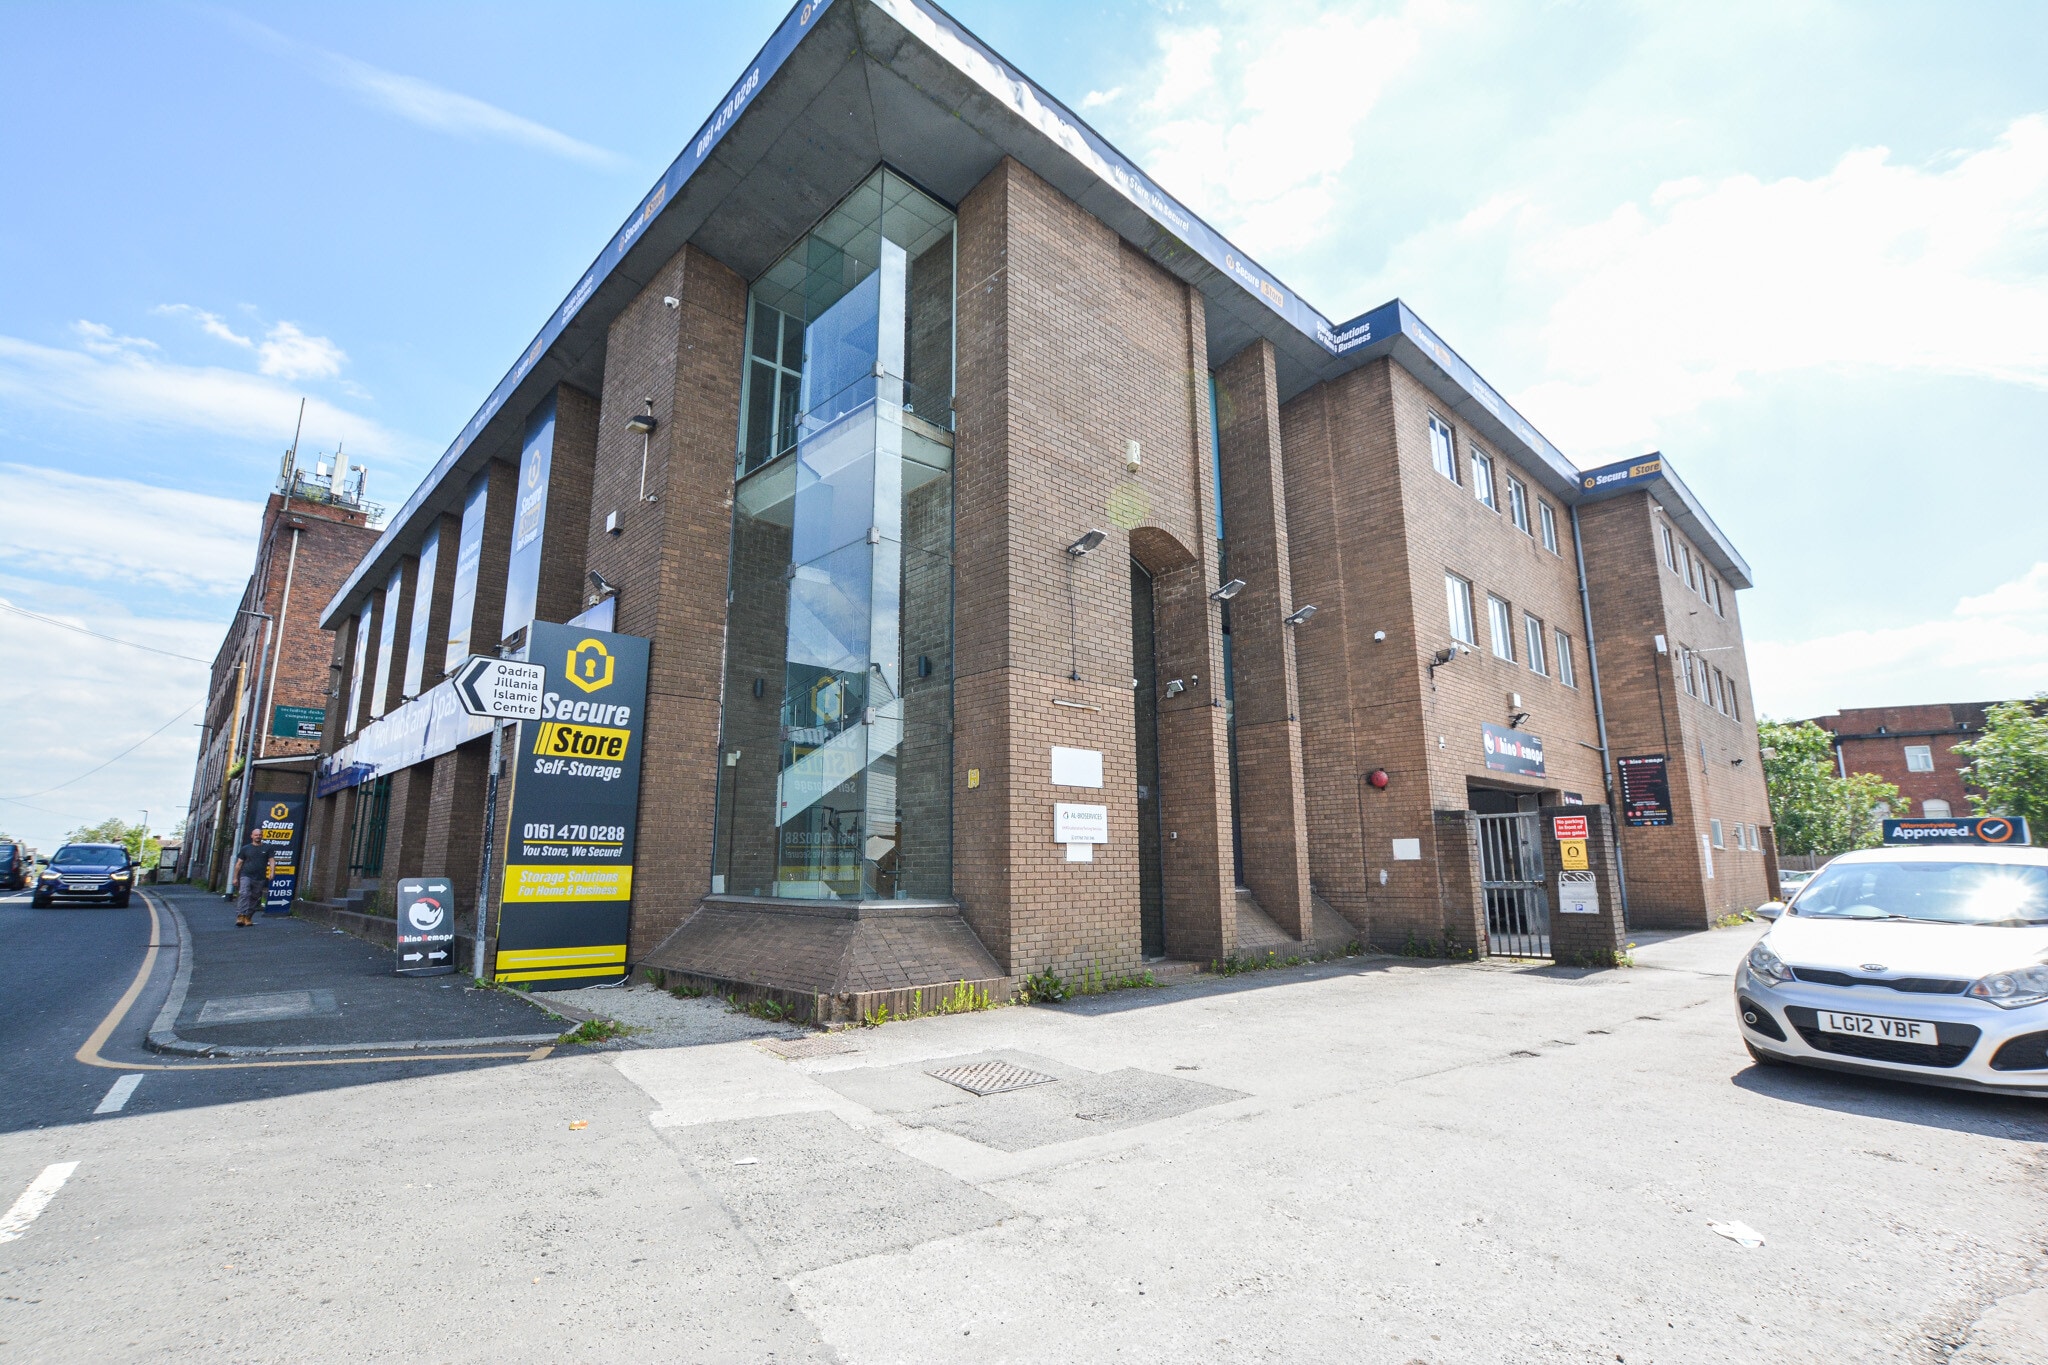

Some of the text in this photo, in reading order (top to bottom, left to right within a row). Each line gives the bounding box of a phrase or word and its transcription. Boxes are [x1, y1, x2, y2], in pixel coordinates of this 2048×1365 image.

[696, 67, 759, 158] 0161 470 0288
[1235, 261, 1282, 305] Secure Store
[1338, 332, 1371, 352] Business
[1596, 462, 1660, 484] Secure Store
[498, 664, 538, 678] Qadria
[494, 677, 538, 690] Jillania
[494, 688, 538, 702] Islamic
[431, 690, 457, 732] Spas
[493, 701, 536, 714] Centre
[542, 692, 630, 726] Secure
[554, 727, 622, 756] Store
[534, 758, 622, 782] Self-Storage
[262, 820, 294, 830] Secure
[524, 823, 625, 841] 0161 470 0288
[266, 830, 290, 839] Store
[522, 845, 622, 858] You Store, We Secure!
[520, 870, 618, 885] Storage Solutions
[518, 885, 534, 896] For
[536, 885, 565, 896] Home
[575, 885, 618, 895] Business
[399, 934, 454, 944] RhinoRemaps
[1830, 1014, 1920, 1038] LG12 VBF
